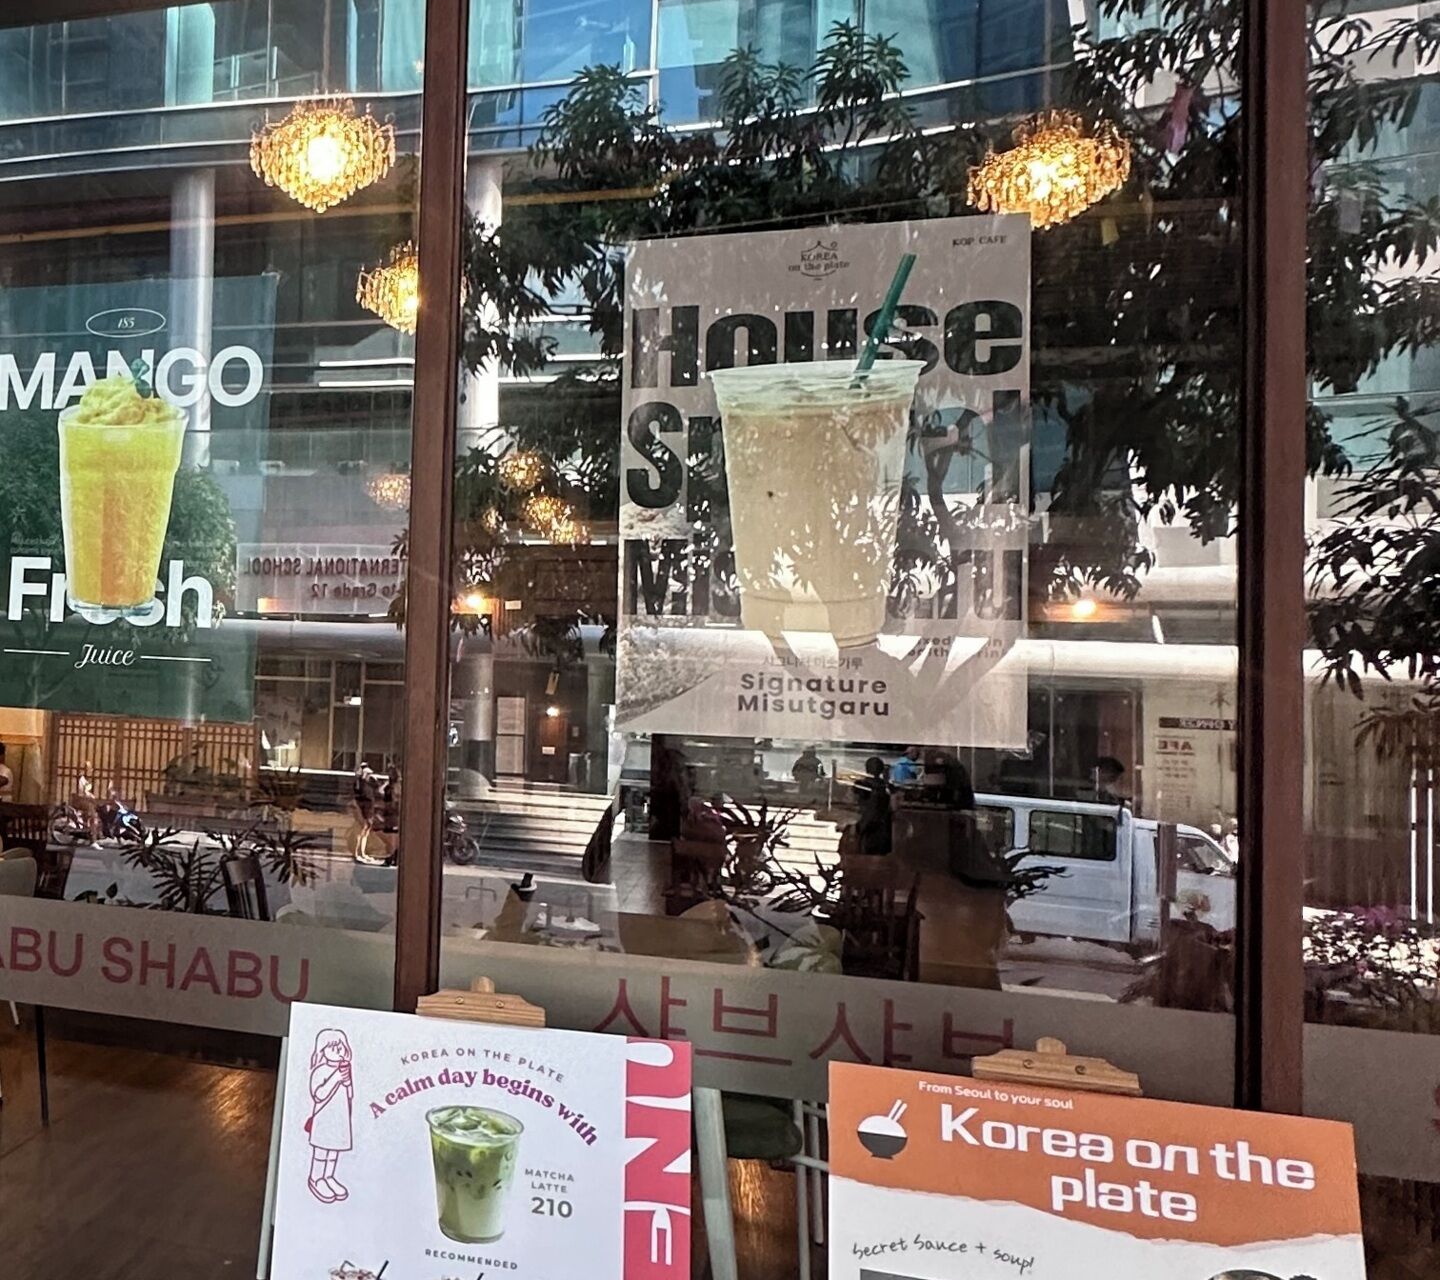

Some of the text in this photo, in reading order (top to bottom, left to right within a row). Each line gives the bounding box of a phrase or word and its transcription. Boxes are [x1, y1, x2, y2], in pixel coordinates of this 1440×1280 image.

[978, 234, 1007, 245] CAFE
[116, 315, 135, 329] 185
[7, 556, 214, 629] Frsh
[74, 643, 136, 670] Juice
[740, 672, 888, 696] Signature
[738, 694, 891, 719] Misutgaru
[101, 936, 310, 1004] SHABU
[400, 1048, 565, 1083] KOREA ON THE PLATE
[369, 1068, 599, 1146] A calm day begins with
[918, 1080, 1074, 1110] From Seoul to your soul
[940, 1103, 1316, 1191] Korea on the
[524, 1167, 575, 1182] MATCHA
[530, 1181, 568, 1194] LATTE
[530, 1195, 574, 1219] 210
[1050, 1167, 1198, 1222] plate
[424, 1248, 518, 1271] RECOMMENDED
